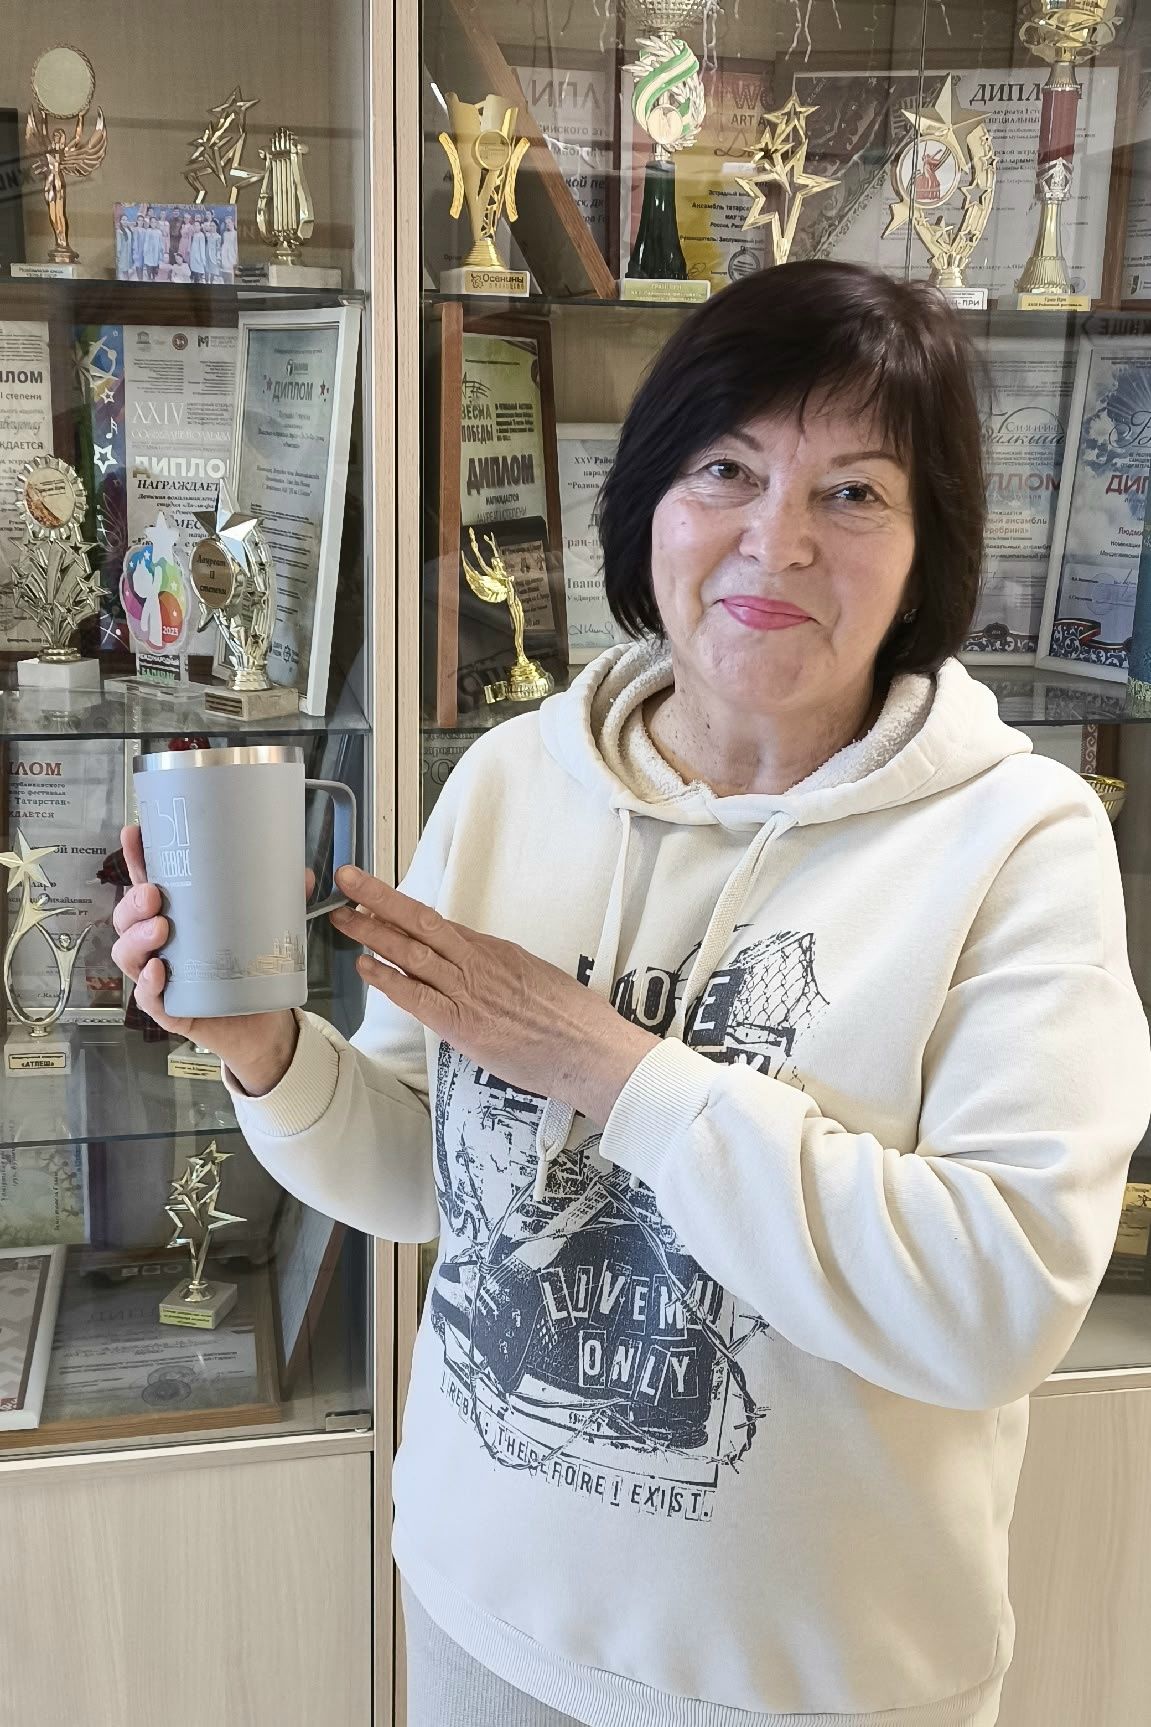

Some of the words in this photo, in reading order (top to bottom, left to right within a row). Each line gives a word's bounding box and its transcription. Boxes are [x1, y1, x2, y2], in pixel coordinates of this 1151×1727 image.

[731, 114, 755, 126] ART
[691, 202, 725, 211] Ансамбль
[482, 273, 524, 283] Осенины
[6, 392, 42, 401] степени
[272, 380, 314, 403] ДИПЛОМ
[133, 456, 230, 479] ДИПЛО
[466, 453, 535, 496] ДИПЛОМ
[1005, 516, 1047, 525] ансамбль
[71, 847, 107, 855] песни
[542, 1271, 648, 1321] LIVE
[583, 1339, 690, 1396] ONLY
[630, 1484, 710, 1517] EXIST.
